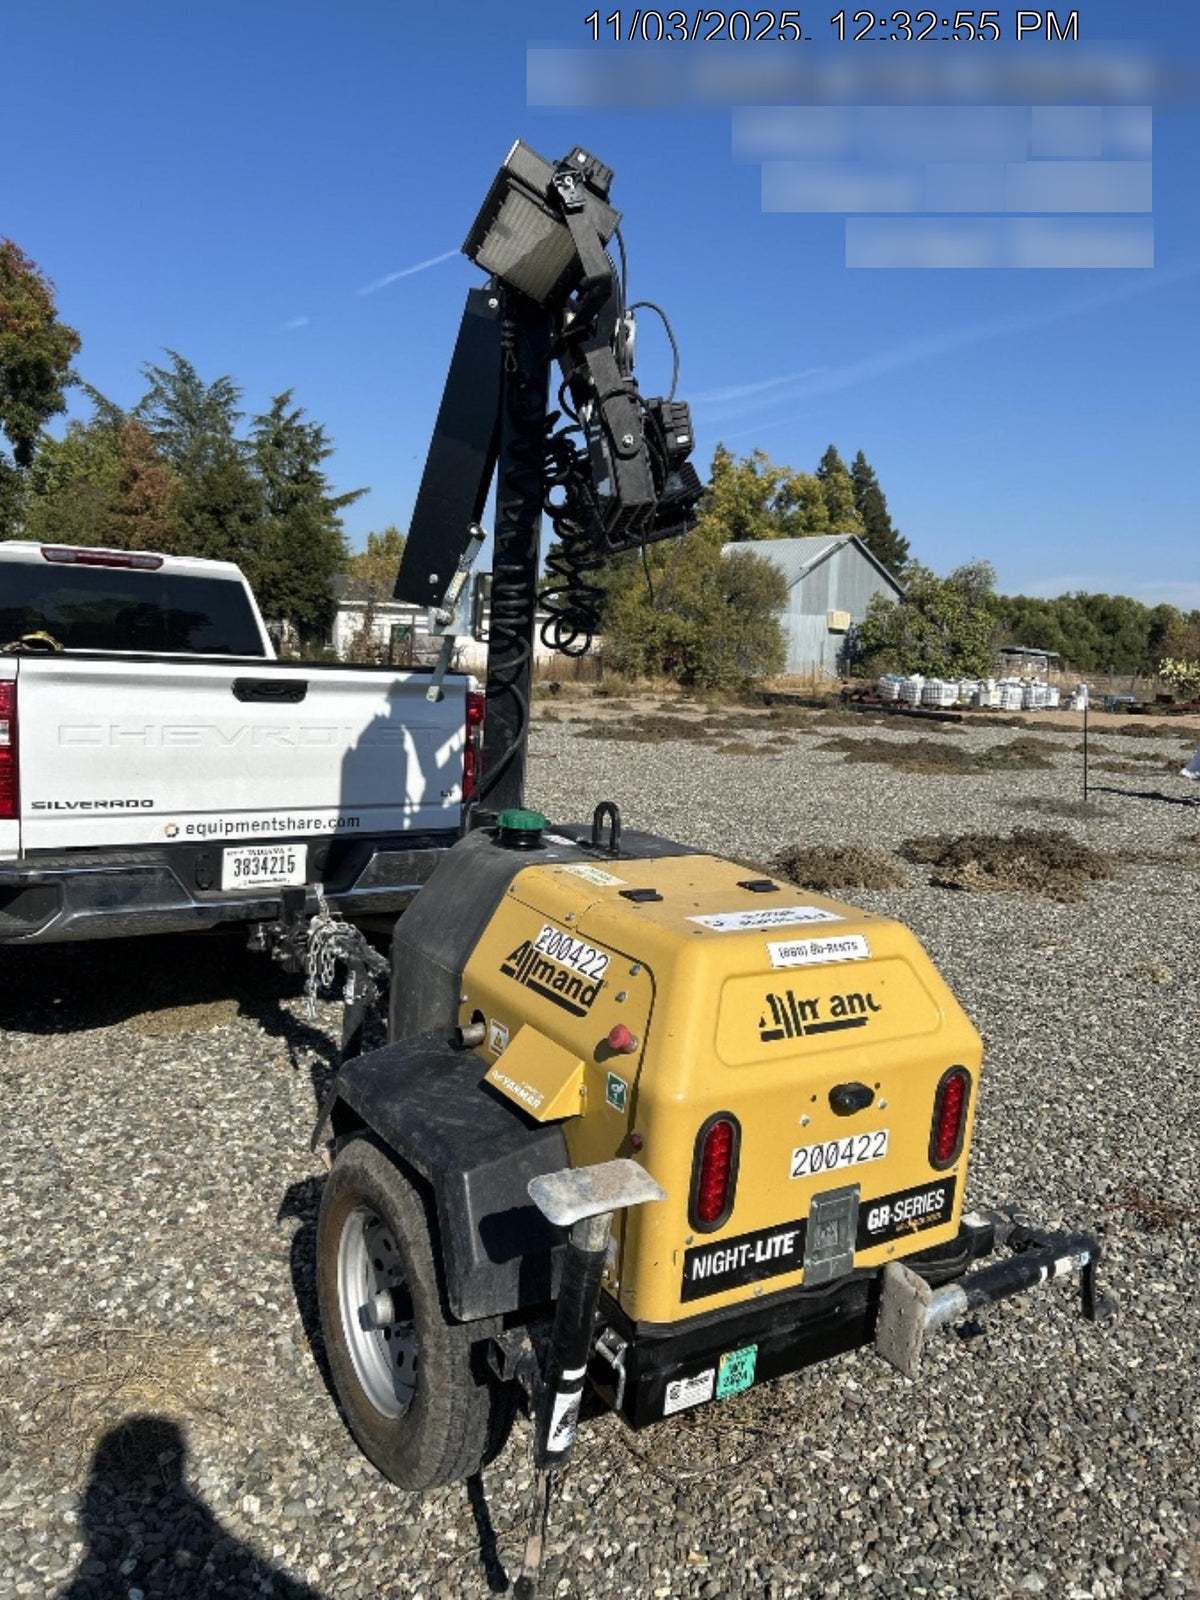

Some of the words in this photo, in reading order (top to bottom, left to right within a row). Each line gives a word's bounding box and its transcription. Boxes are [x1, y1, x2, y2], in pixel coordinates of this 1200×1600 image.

[58, 724, 441, 748] CHEVROLET
[31, 798, 155, 811] SILVERADO
[185, 814, 360, 836] equipmentshare.com
[233, 854, 296, 877] 3834215
[535, 926, 609, 980] 200422
[503, 940, 605, 1009] Allmand
[502, 1076, 542, 1109] YANMAR
[792, 1131, 887, 1178] 200422
[867, 1188, 945, 1231] GR-SERIES
[691, 1234, 796, 1281] NIGHT-LITE
